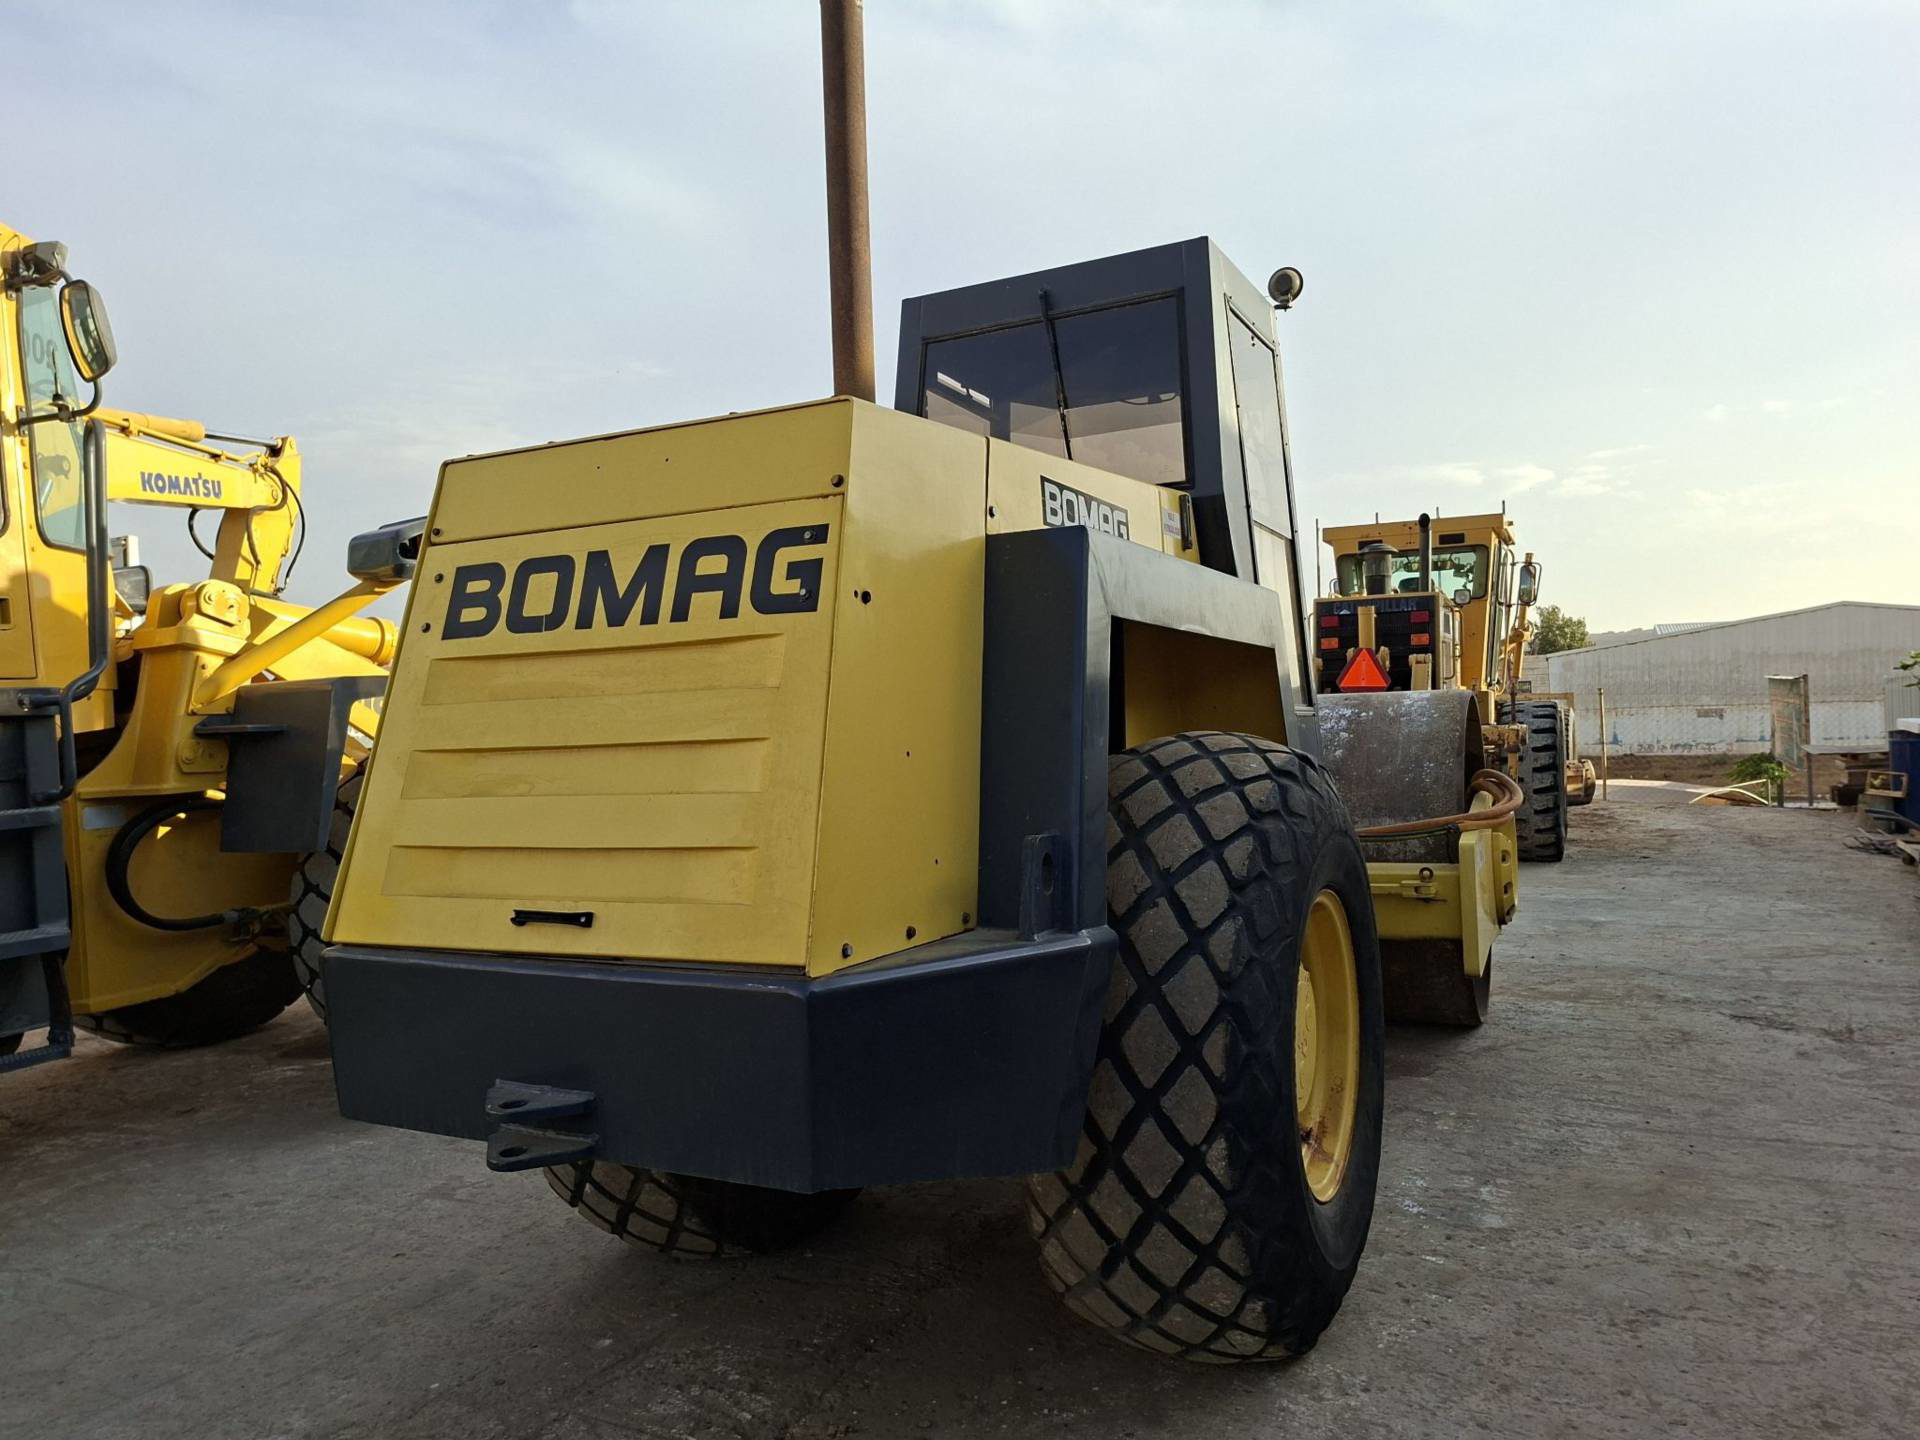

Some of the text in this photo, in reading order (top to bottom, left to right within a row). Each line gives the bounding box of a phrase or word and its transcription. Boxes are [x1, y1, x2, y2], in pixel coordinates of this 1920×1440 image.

[140, 471, 222, 499] KOMATSU
[1043, 481, 1129, 540] BOMAG
[441, 523, 831, 640] BOMAG
